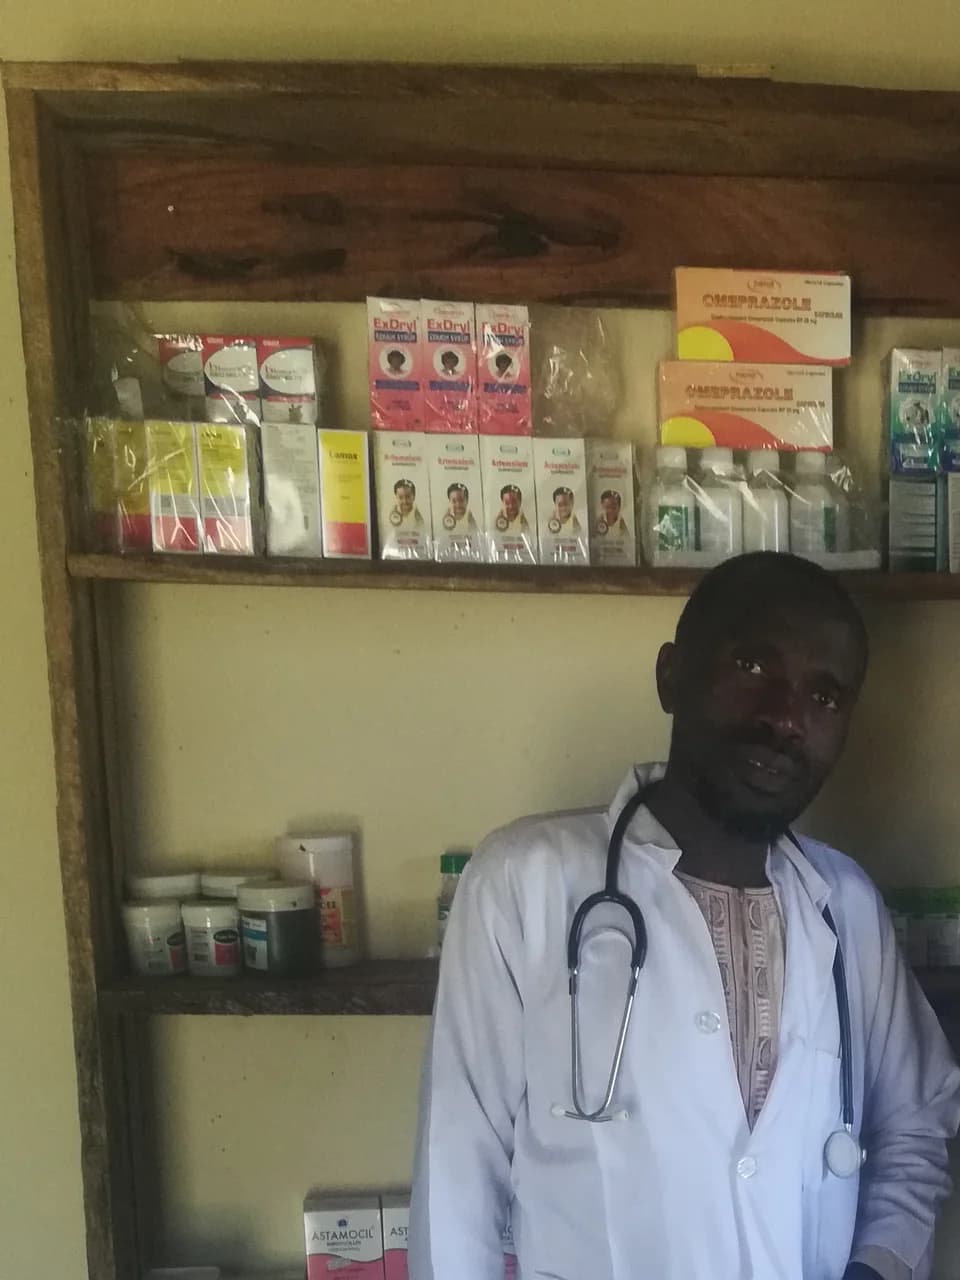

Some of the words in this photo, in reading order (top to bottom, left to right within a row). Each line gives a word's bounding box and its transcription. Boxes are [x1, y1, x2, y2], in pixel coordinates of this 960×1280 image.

[702, 293, 812, 311] OMEPRAZOLE
[373, 318, 417, 334] ExDryl
[427, 318, 470, 334] ExDryl
[686, 384, 793, 401] OMEPRAZOLE
[312, 1228, 374, 1241] ASTAMOCIL
